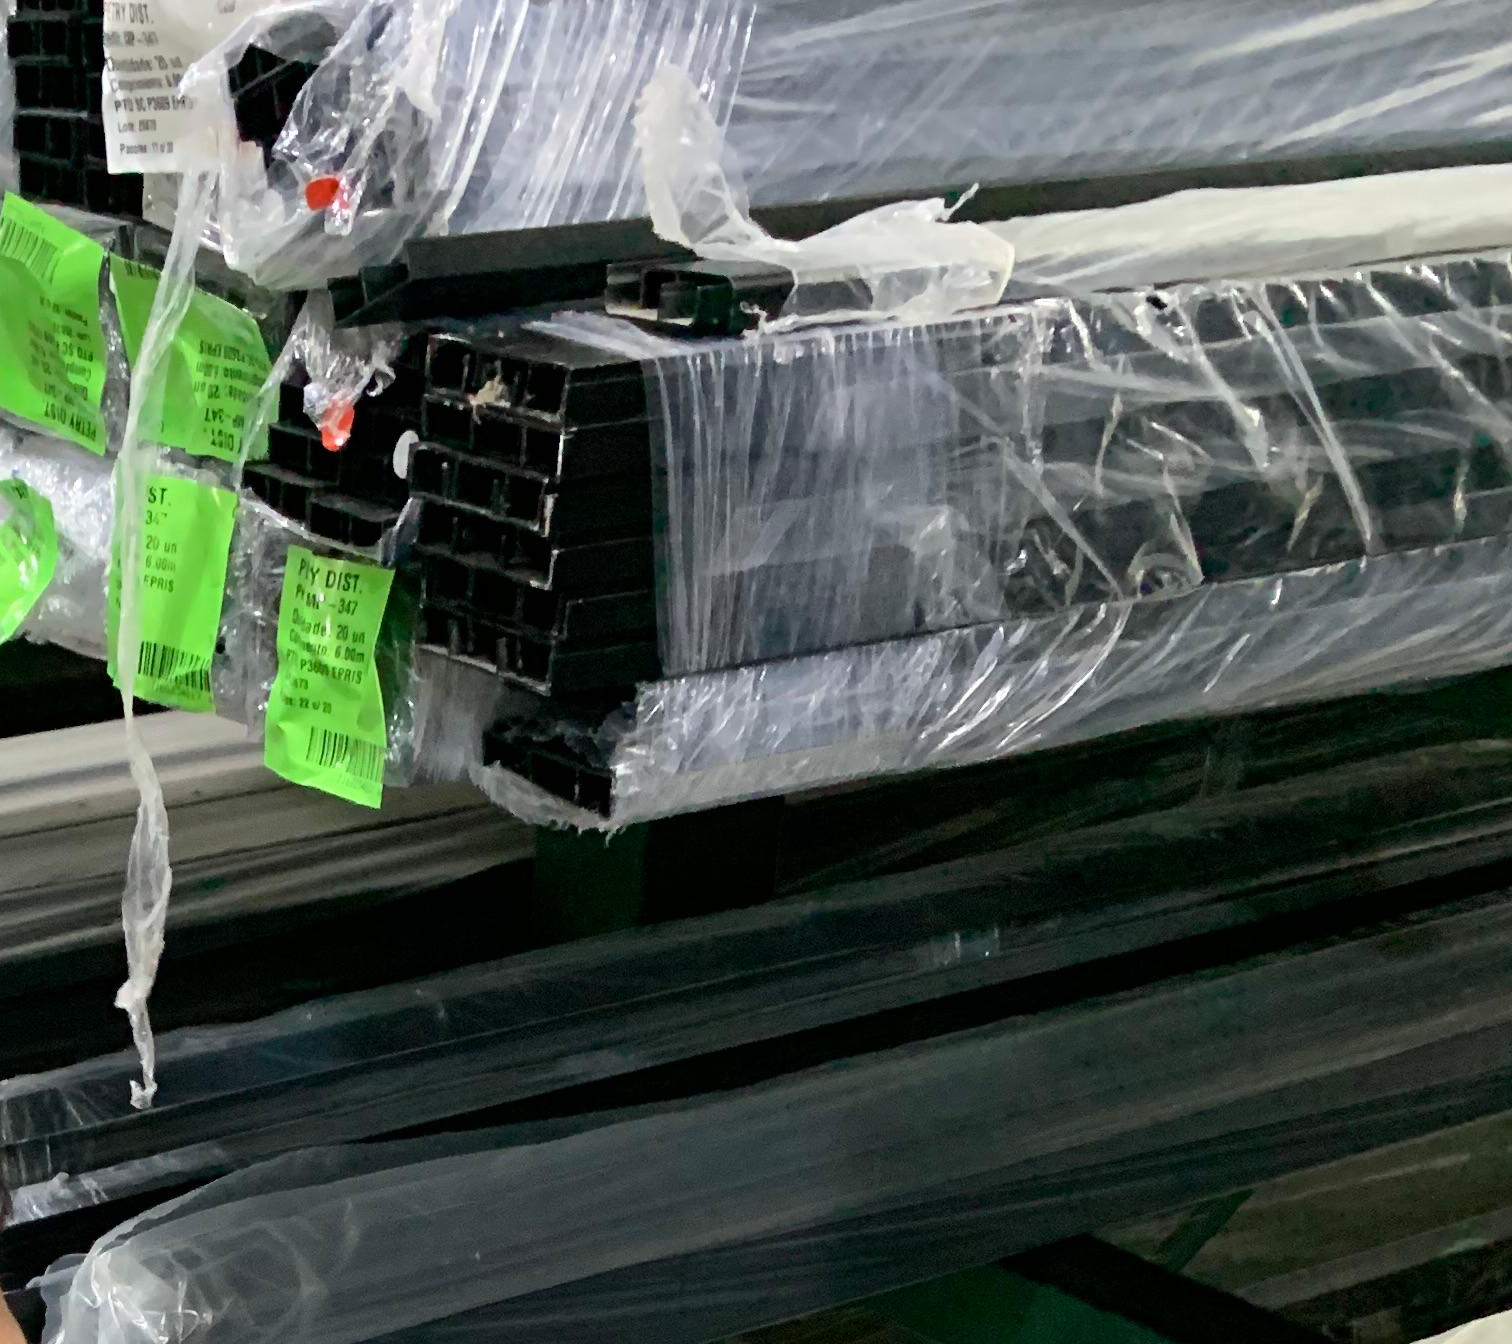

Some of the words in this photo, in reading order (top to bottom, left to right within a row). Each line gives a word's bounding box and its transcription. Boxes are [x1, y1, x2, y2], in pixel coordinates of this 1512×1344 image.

[145, 535, 160, 550] 20
[326, 570, 362, 594] DIST.
[337, 624, 349, 641] 20
